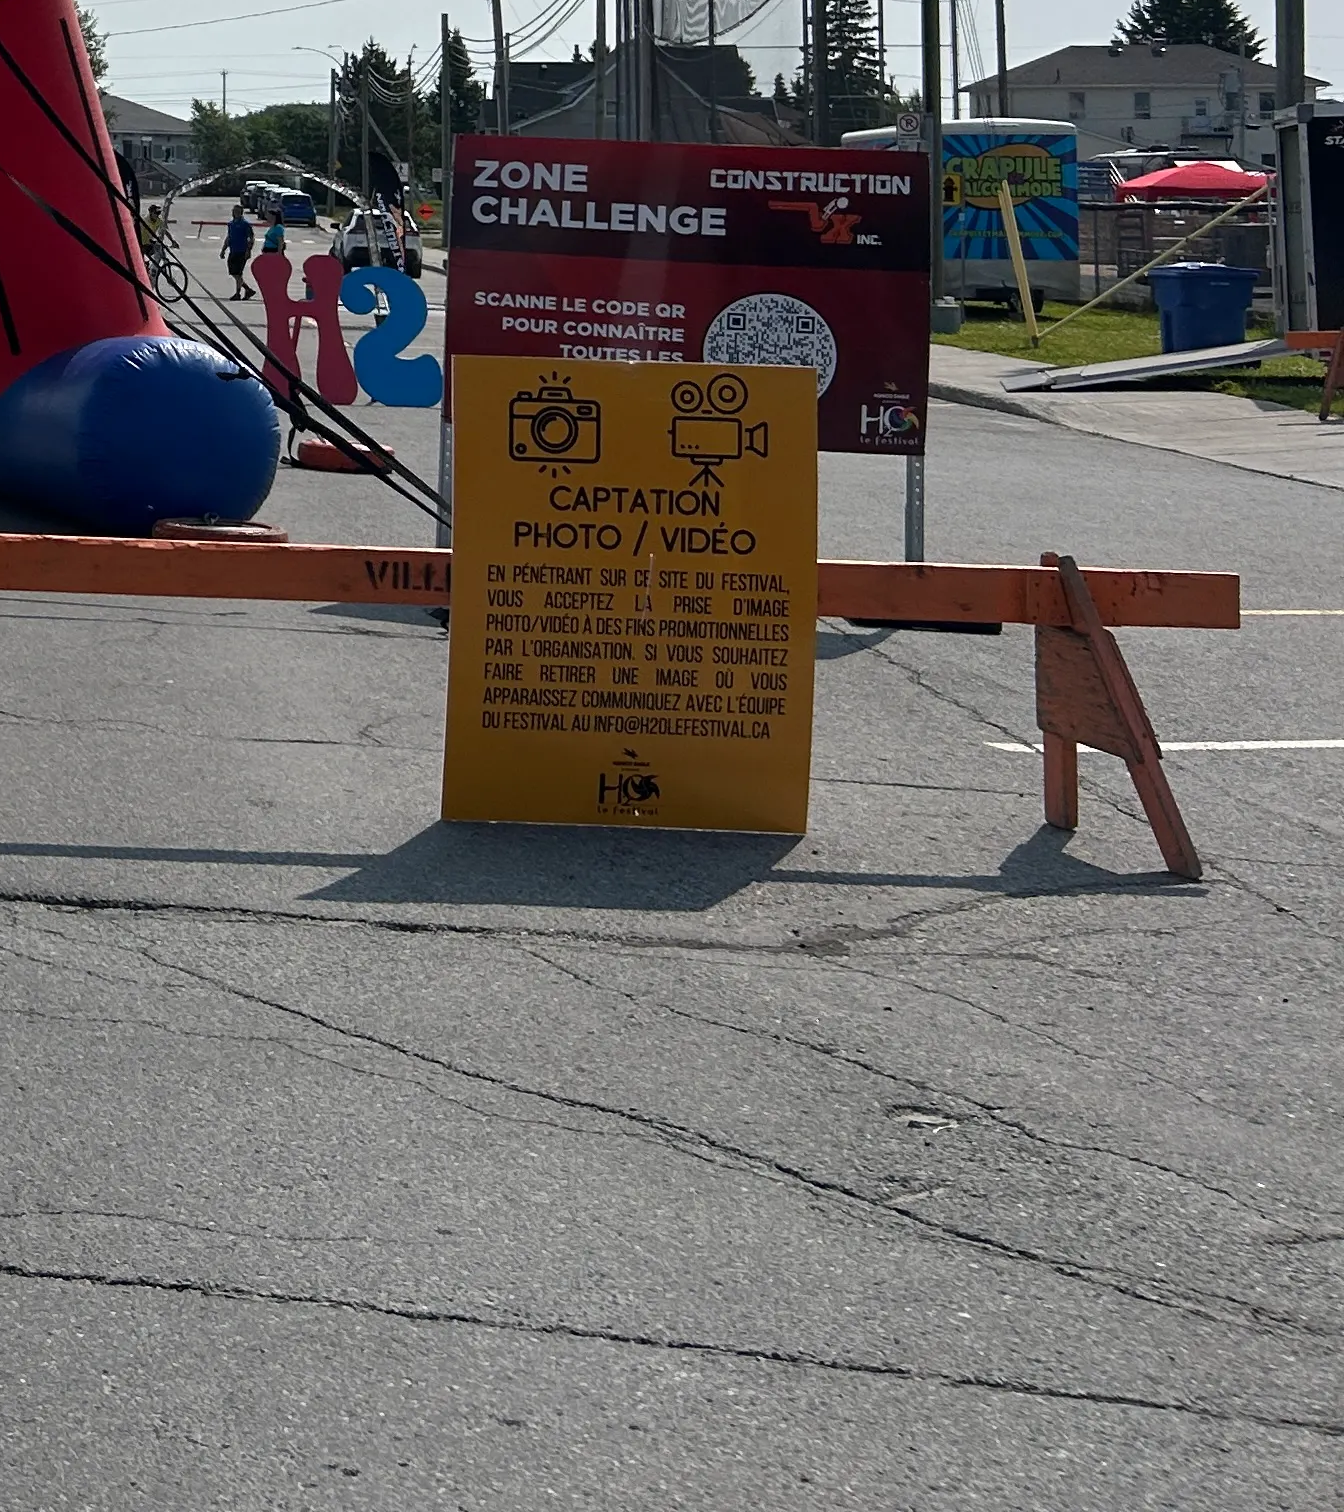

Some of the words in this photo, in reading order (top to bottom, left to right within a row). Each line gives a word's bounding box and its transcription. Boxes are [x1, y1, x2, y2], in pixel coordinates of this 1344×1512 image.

[473, 159, 588, 193] ZONE
[709, 168, 911, 194] CONSTRUCTION
[946, 156, 1061, 180] CRAPULE
[471, 195, 727, 236] CHALLENGE
[856, 234, 883, 245] INC.
[474, 291, 557, 311] SCANNE
[562, 297, 587, 313] LE
[592, 299, 650, 317] CODE
[655, 303, 686, 319] QR
[502, 316, 558, 334] POUR
[563, 322, 685, 343] CONNAÎTRE
[559, 344, 641, 361] TOUTES
[875, 435, 919, 446] festival
[549, 486, 720, 517] CAPTATION
[514, 521, 622, 550] PHOTO
[632, 519, 649, 557] /
[660, 521, 756, 555] VIDÉO
[487, 564, 506, 582] EN
[513, 563, 592, 585] PÉNÉTRANT
[600, 568, 626, 587] SUR
[634, 569, 650, 587] CE
[659, 570, 688, 588] SITE
[696, 572, 714, 589] DU
[721, 572, 790, 595] FESTIVAL,
[487, 589, 523, 607] VOUS
[544, 591, 614, 611] ACCEPTEZ
[634, 594, 652, 612] LA
[673, 595, 712, 614] PRISE
[733, 598, 789, 617] D'IMAGE
[486, 613, 579, 634] PHOTO/VIDÉO
[582, 614, 593, 635] À
[596, 617, 622, 636] DES
[625, 618, 656, 636] FINS
[659, 620, 789, 641] PROMOTIONNELLES
[485, 638, 512, 656] PAR
[522, 639, 635, 661] L'ORGANISATION.
[644, 643, 658, 661] SI
[666, 644, 703, 663] VOUS
[712, 646, 789, 667] SOUHAITEZ
[484, 662, 523, 681] FAIRE
[540, 664, 596, 683] RETIRER
[612, 667, 639, 685] UNE
[655, 668, 699, 687] IMAGE
[715, 668, 734, 689] OÙ
[751, 672, 788, 691] VOUS
[483, 687, 578, 707] APPARAISSEZ
[581, 690, 681, 711] COMMUNIQUEZ
[685, 694, 723, 712] AVEC
[727, 693, 786, 715] L'ÉQUIPE
[482, 710, 500, 729] DU
[504, 711, 568, 731] FESTIVAL
[571, 714, 591, 732] AU
